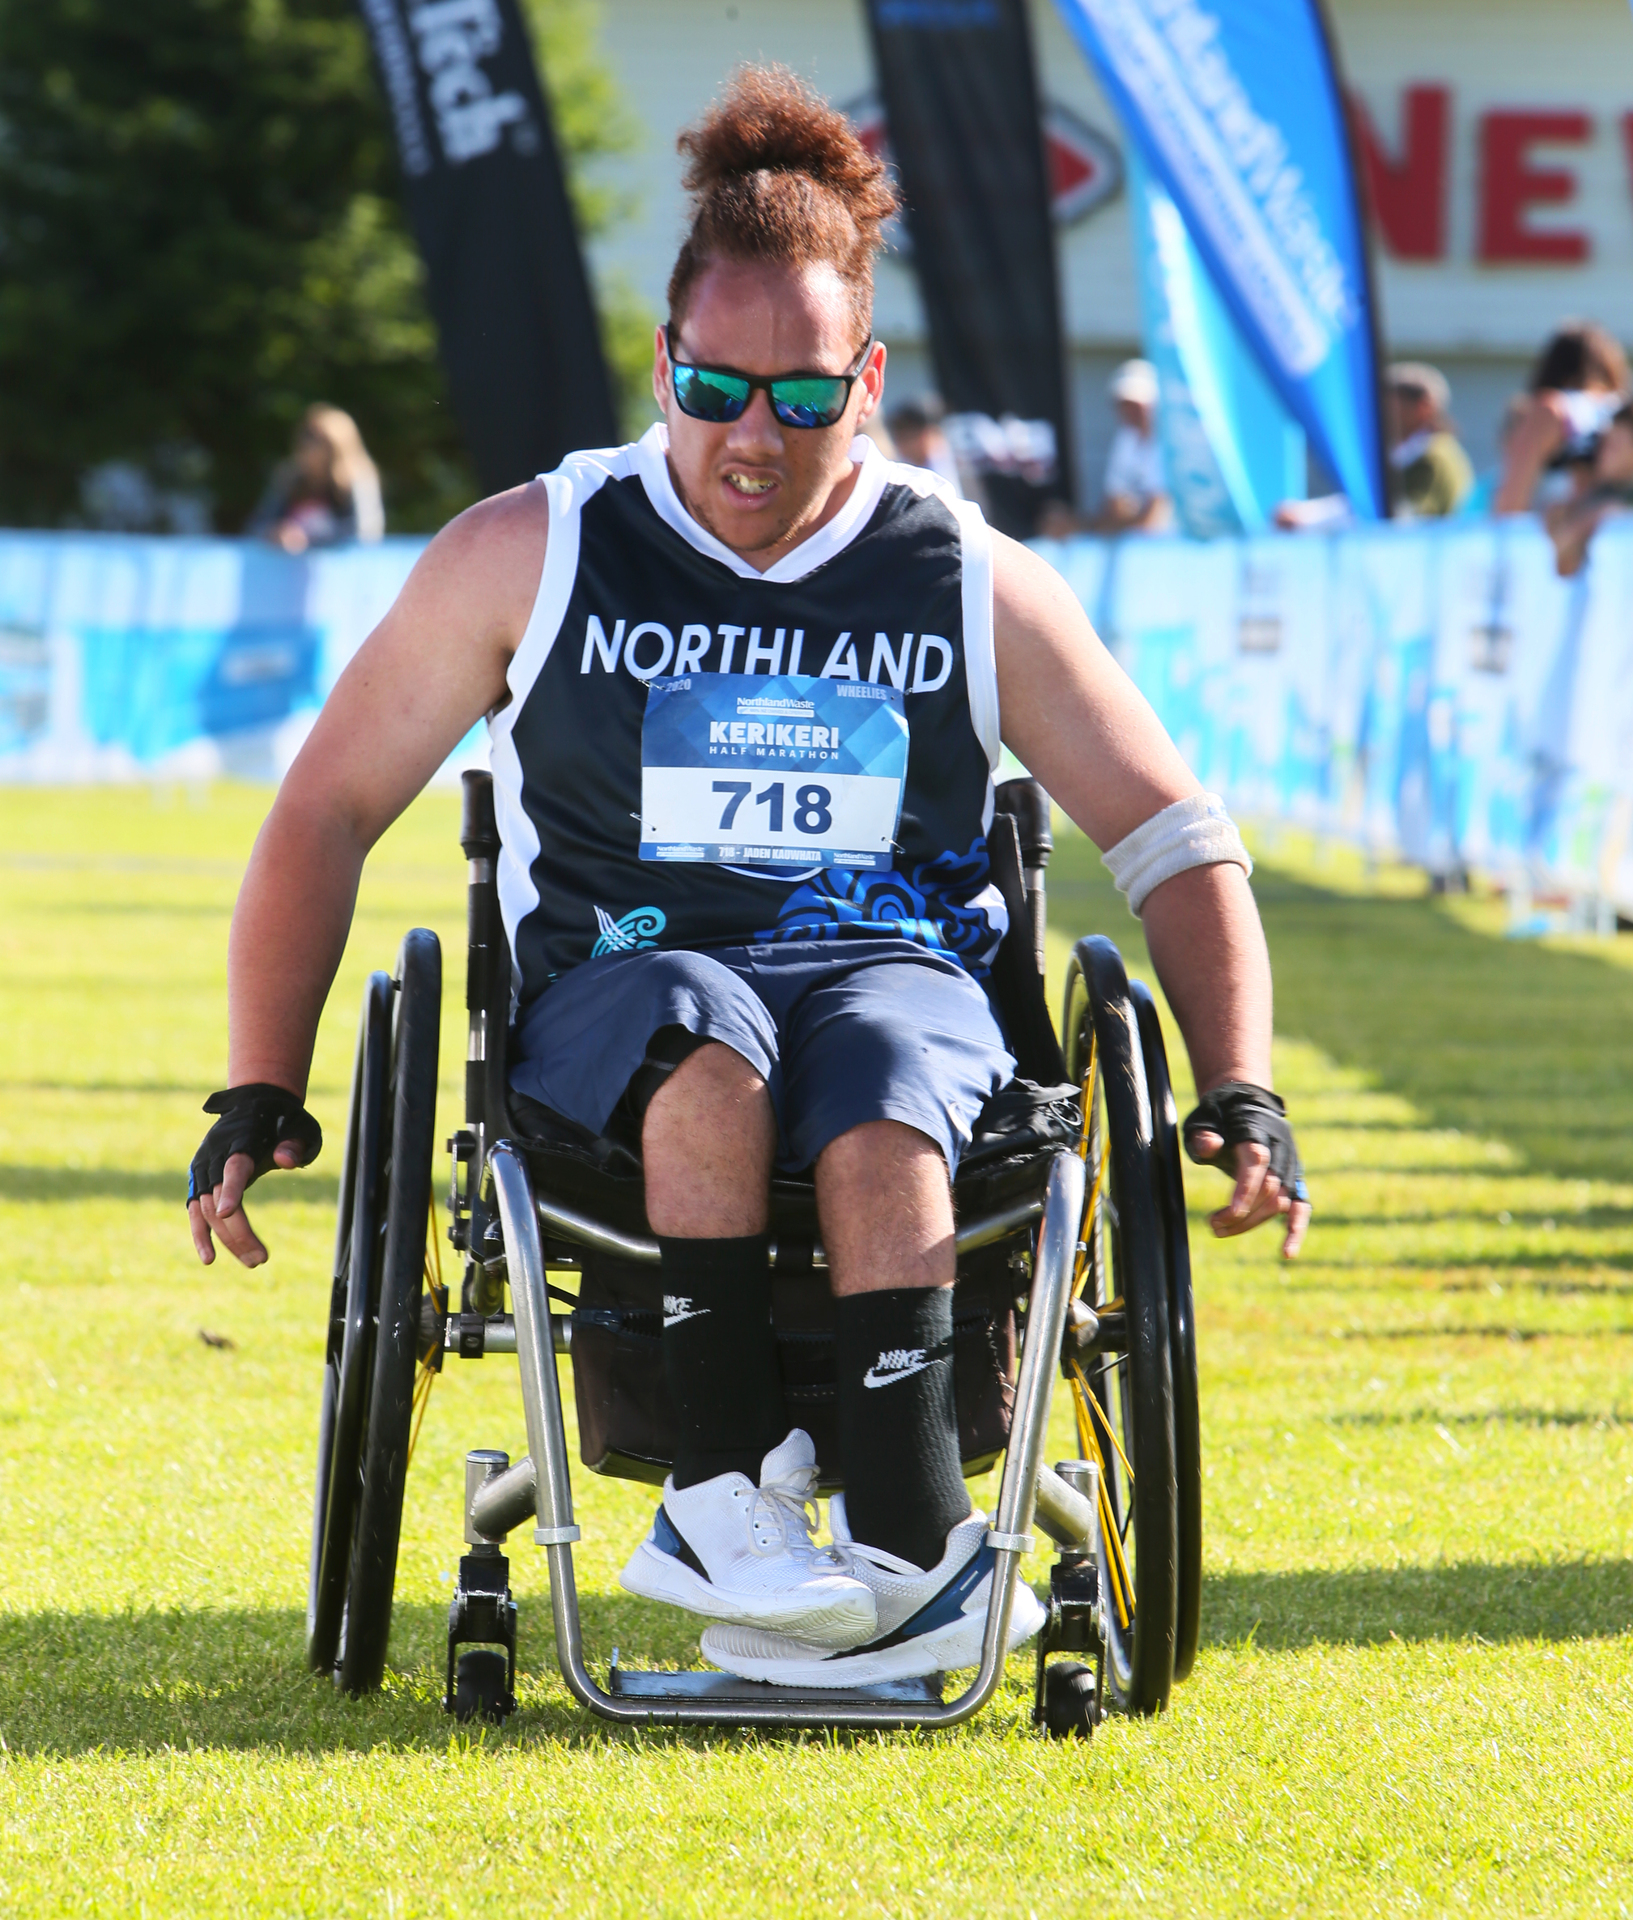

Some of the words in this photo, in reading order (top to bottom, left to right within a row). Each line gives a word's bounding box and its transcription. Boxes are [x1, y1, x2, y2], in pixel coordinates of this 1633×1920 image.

[1342, 80, 1633, 266] NE
[580, 614, 954, 694] NORTHLAND
[665, 678, 692, 693] 2020
[836, 684, 888, 701] WHEELIES
[737, 697, 815, 709] NorthlandWaste
[709, 721, 839, 749] KERIKERI
[709, 746, 747, 756] HALF
[756, 748, 839, 760] MARATHON
[711, 780, 833, 835] 718
[718, 846, 735, 857] 718
[743, 847, 771, 859] JADEN
[771, 848, 822, 861] KAUWHATA
[876, 1349, 927, 1371] NIKE
